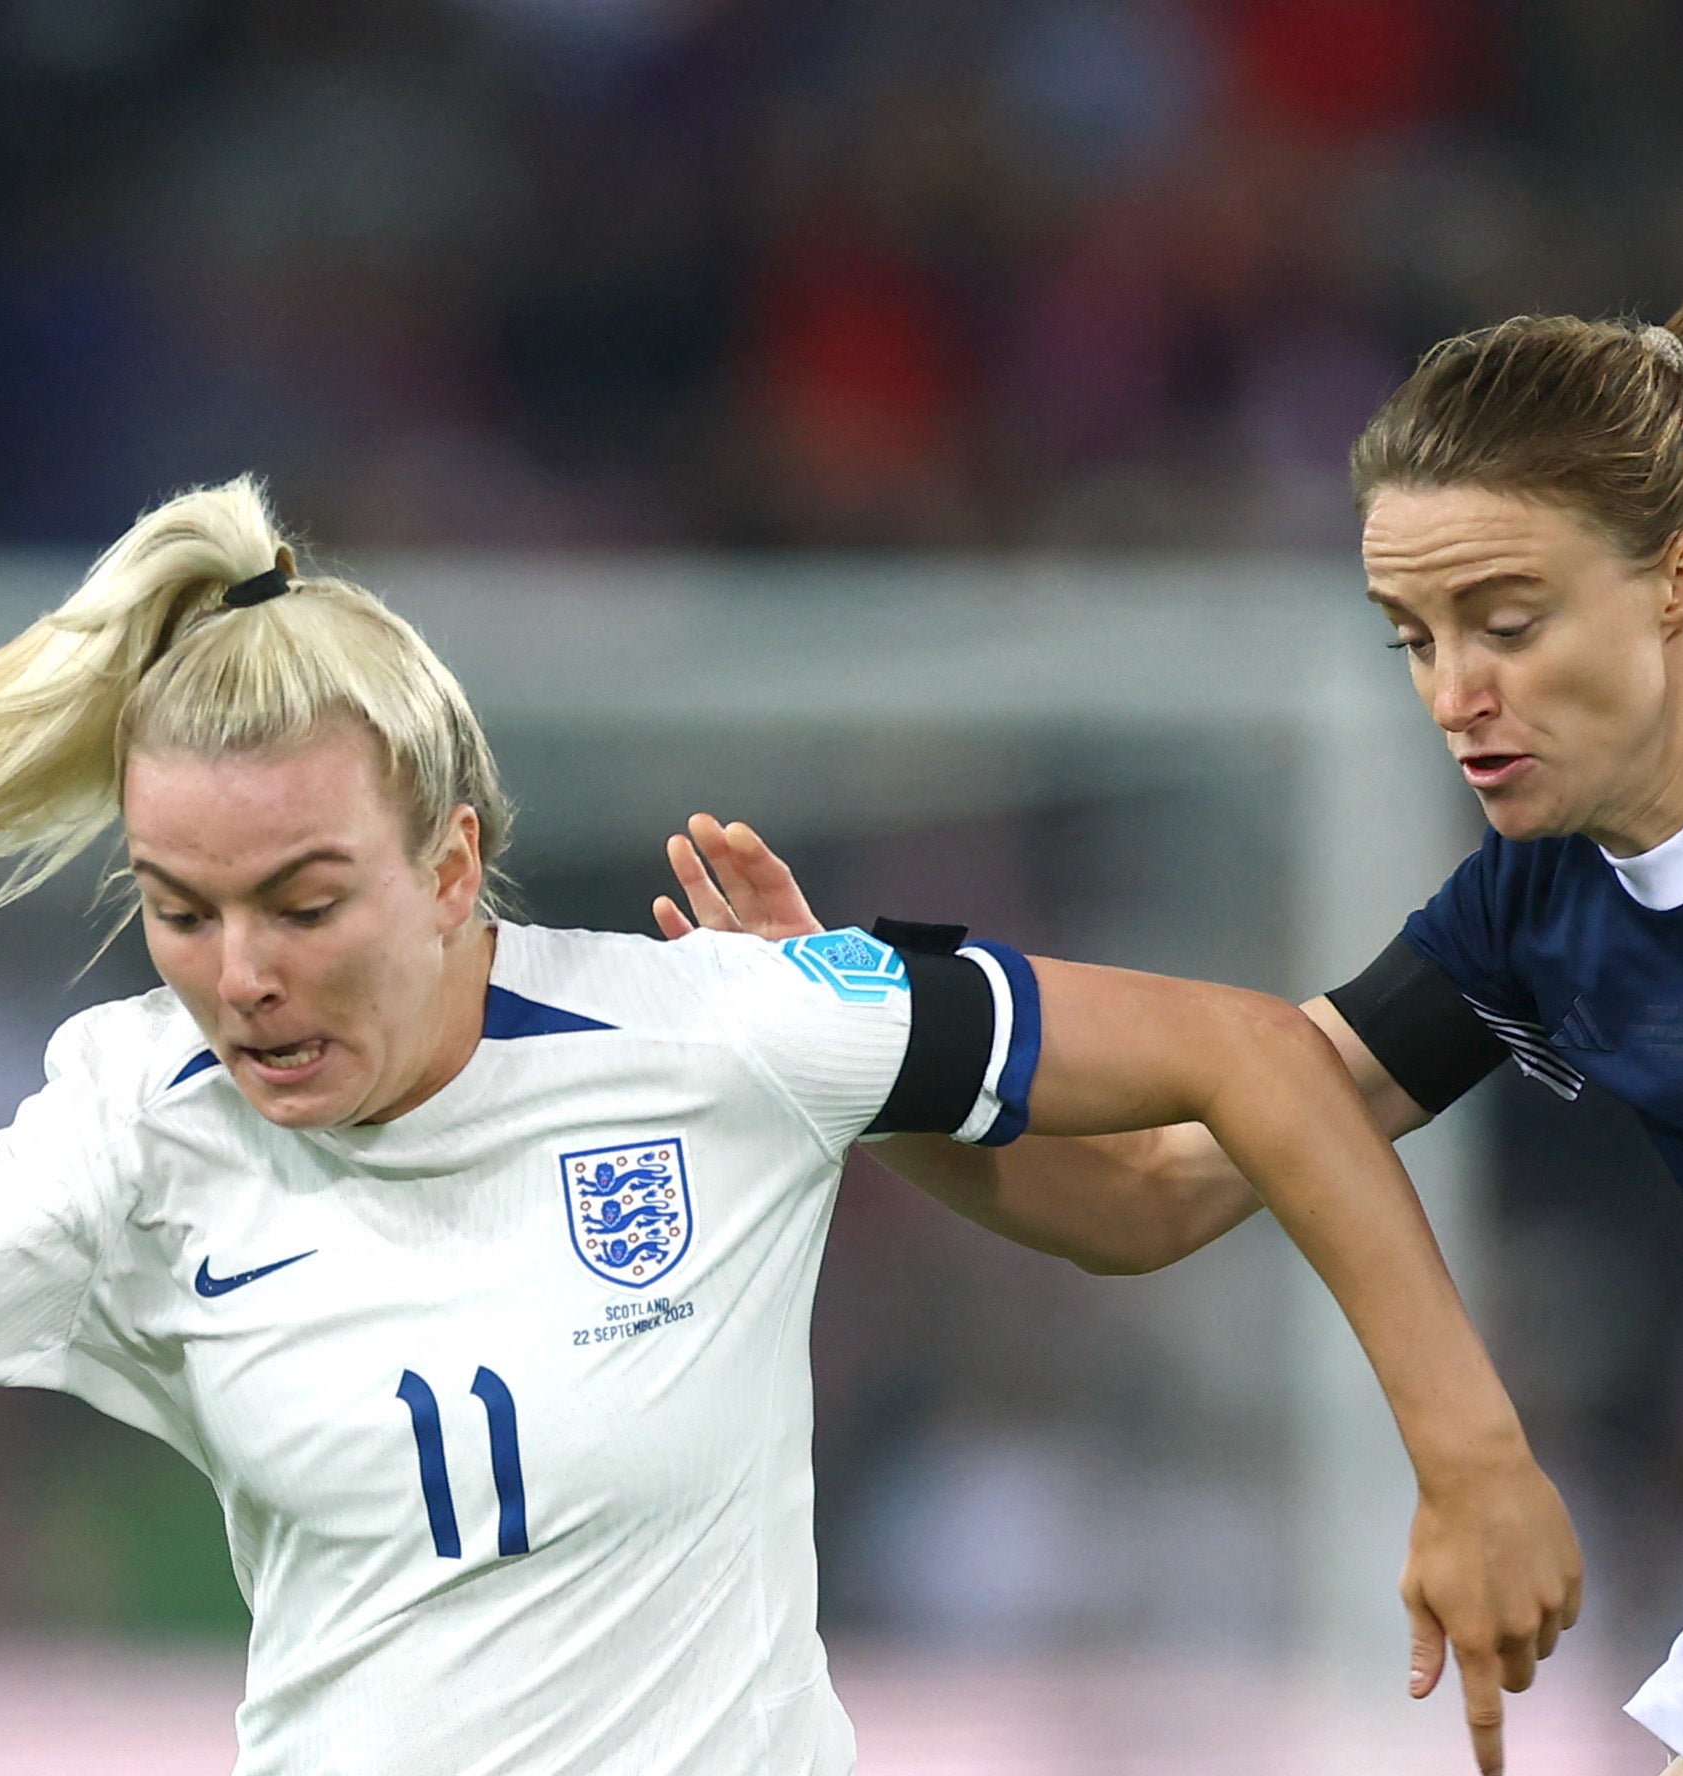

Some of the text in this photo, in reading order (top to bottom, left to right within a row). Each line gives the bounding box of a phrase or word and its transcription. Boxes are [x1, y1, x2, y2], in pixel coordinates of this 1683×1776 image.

[572, 1329, 591, 1346] 22
[663, 1301, 695, 1324] 2023
[605, 1297, 670, 1322] SCOTLAND
[395, 1364, 530, 1560] 11
